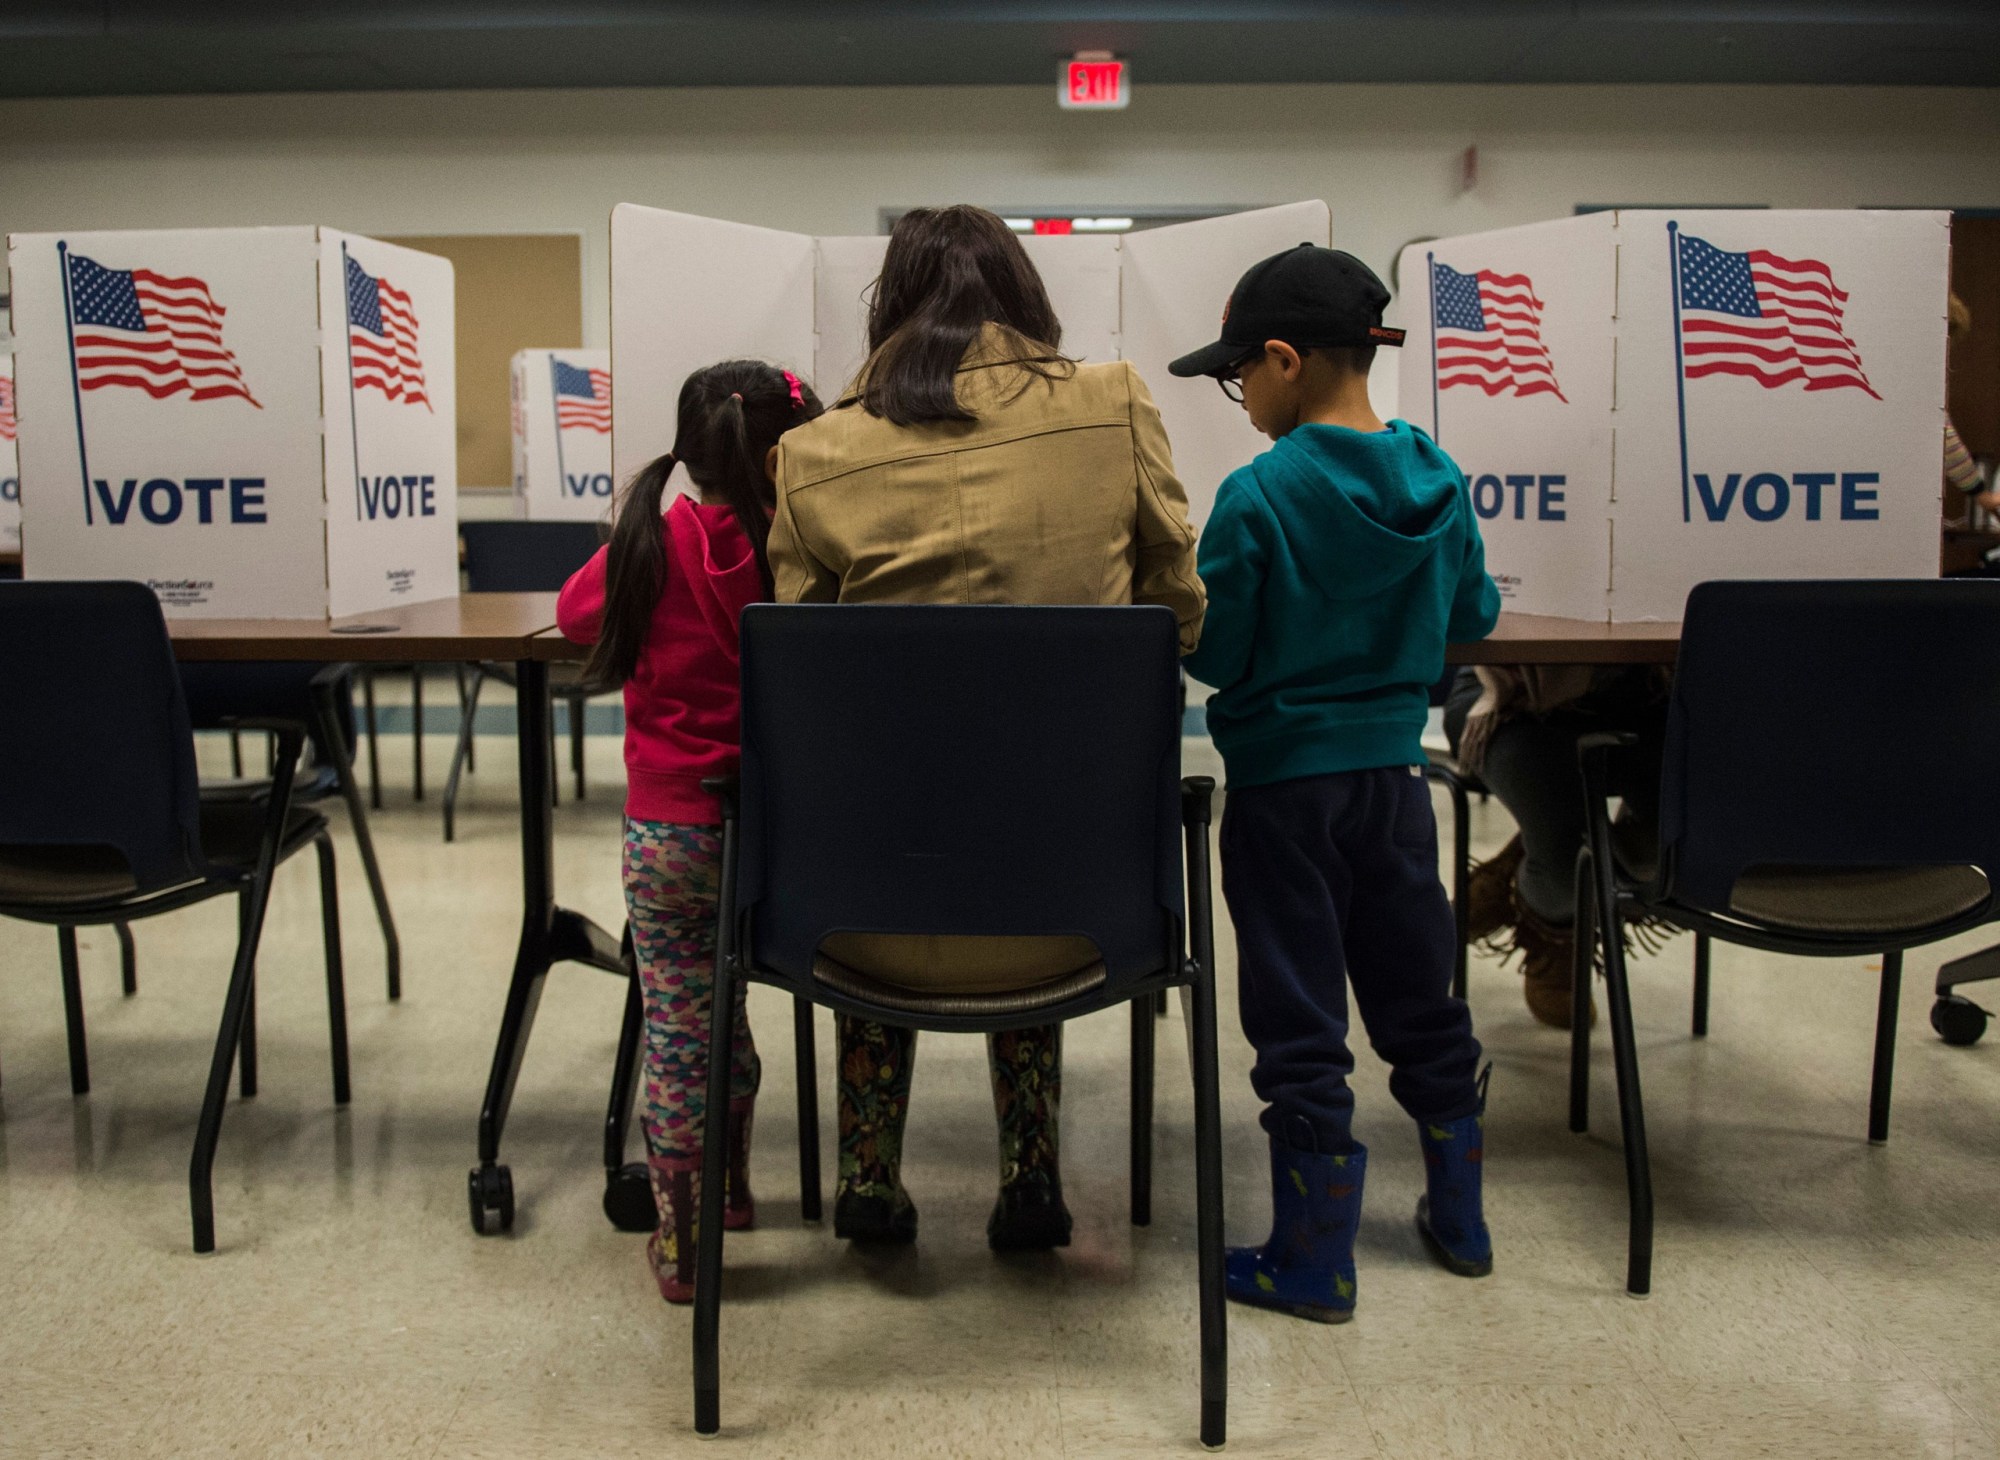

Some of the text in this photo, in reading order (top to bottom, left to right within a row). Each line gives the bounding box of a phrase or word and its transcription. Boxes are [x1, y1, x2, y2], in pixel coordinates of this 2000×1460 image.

[1068, 62, 1122, 102] EXIT
[94, 478, 267, 525] VOTE
[361, 475, 435, 520] VOTE
[567, 473, 612, 497] VO
[1465, 473, 1566, 521] OTE
[1693, 472, 1880, 523] VOTE
